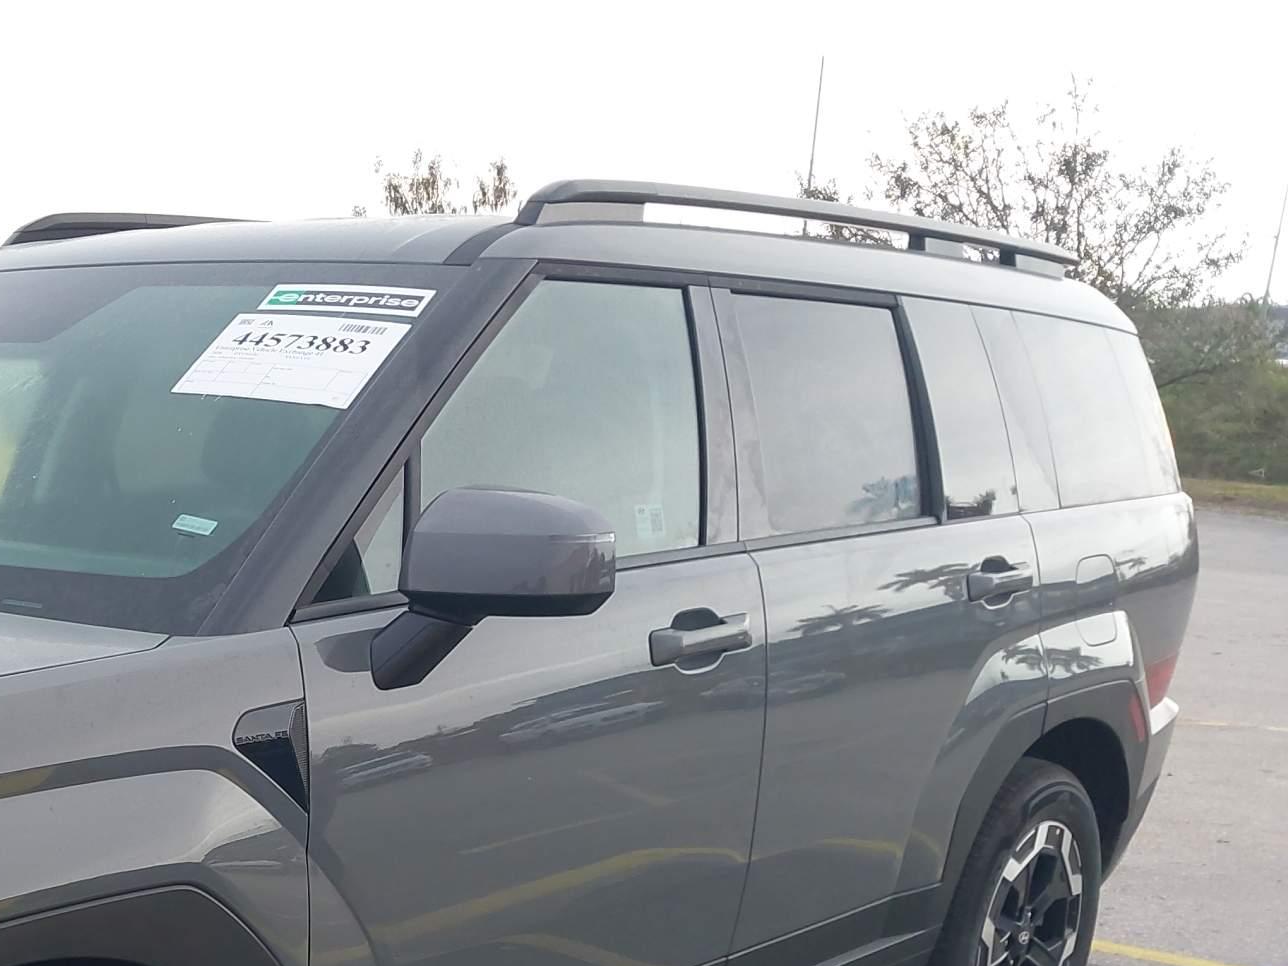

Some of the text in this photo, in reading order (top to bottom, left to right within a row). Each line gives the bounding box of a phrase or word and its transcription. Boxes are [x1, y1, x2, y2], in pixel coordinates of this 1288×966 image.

[270, 292, 420, 308] enterprise
[231, 331, 371, 355] 44573883
[235, 730, 288, 745] SANTA FE
